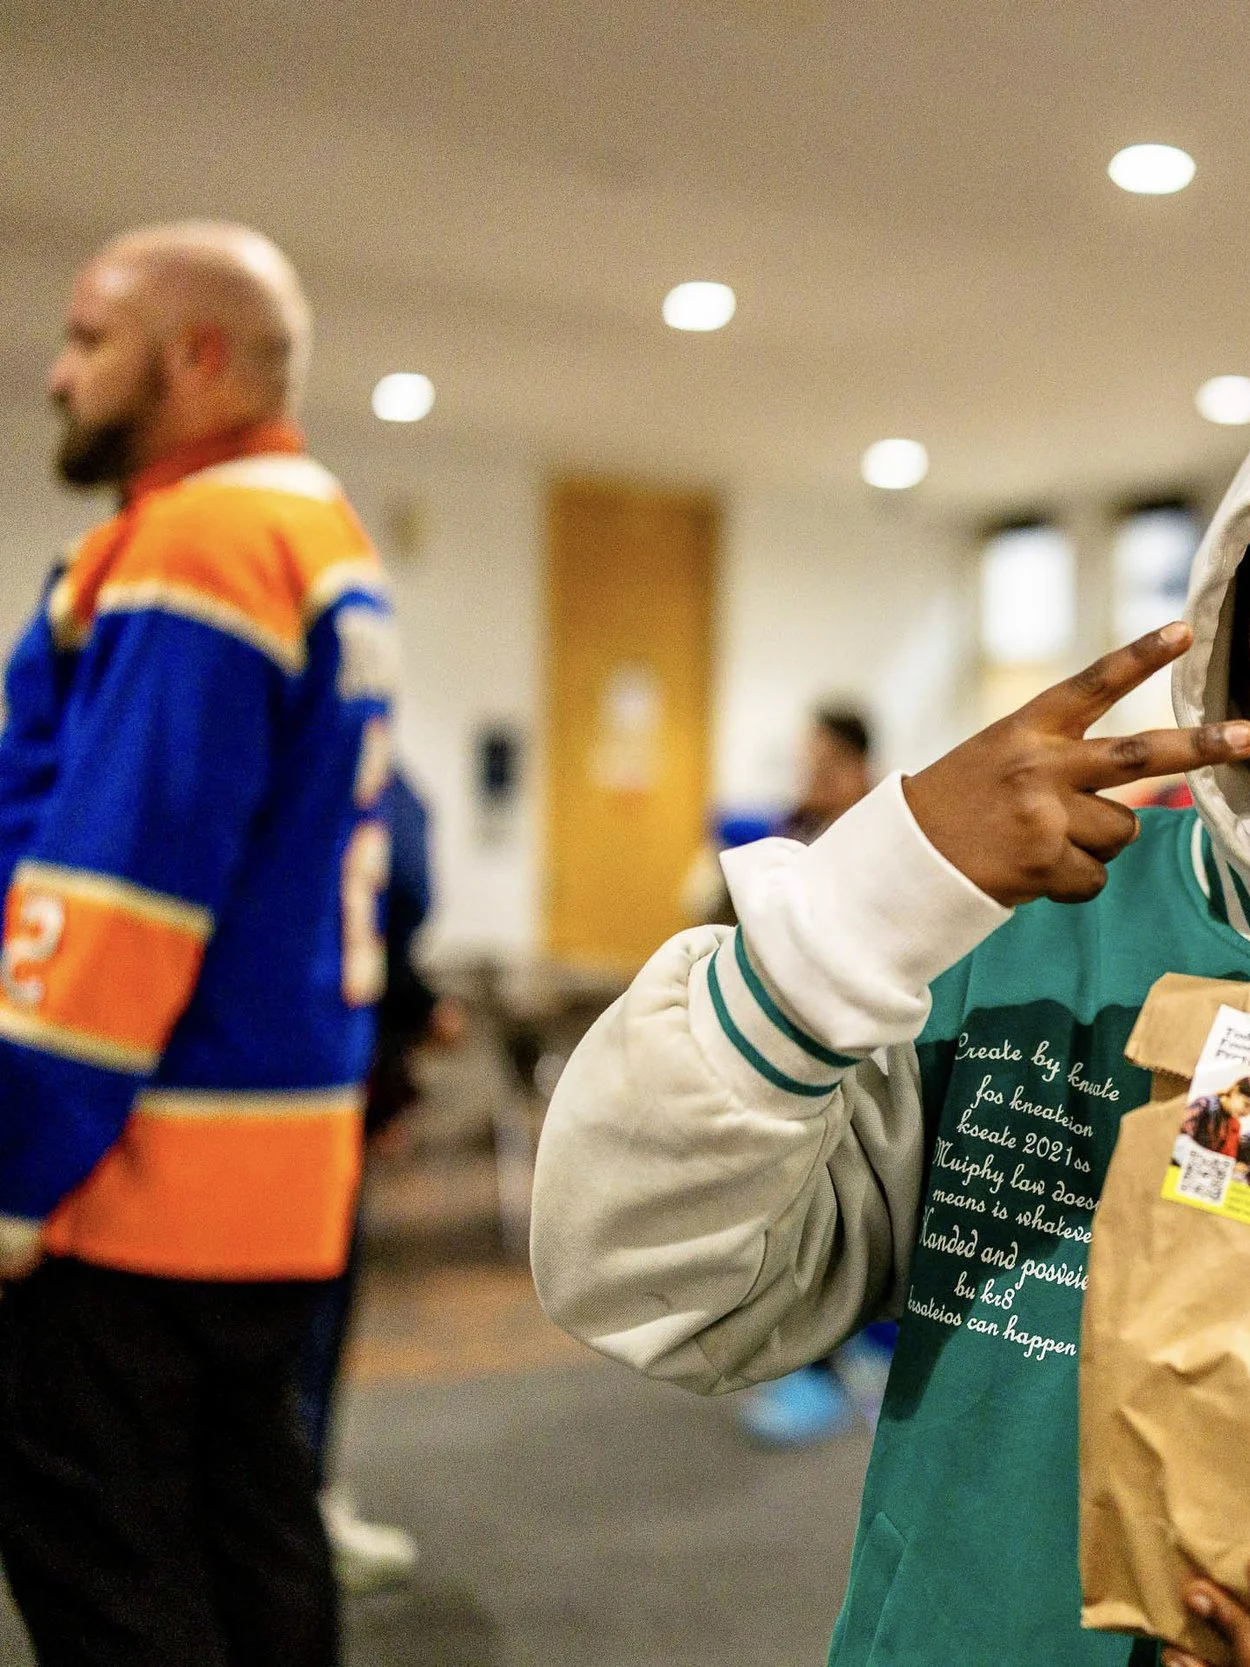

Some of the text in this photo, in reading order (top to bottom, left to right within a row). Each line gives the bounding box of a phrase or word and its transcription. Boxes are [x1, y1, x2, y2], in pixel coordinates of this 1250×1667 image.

[955, 1032, 1022, 1060] Create
[1030, 1040, 1061, 1082] by
[1010, 1163, 1046, 1196] law
[932, 1188, 987, 1213] means
[991, 1199, 1009, 1220] is
[981, 1241, 1019, 1270] and
[967, 1315, 999, 1337] can
[1002, 1314, 1078, 1361] happen
